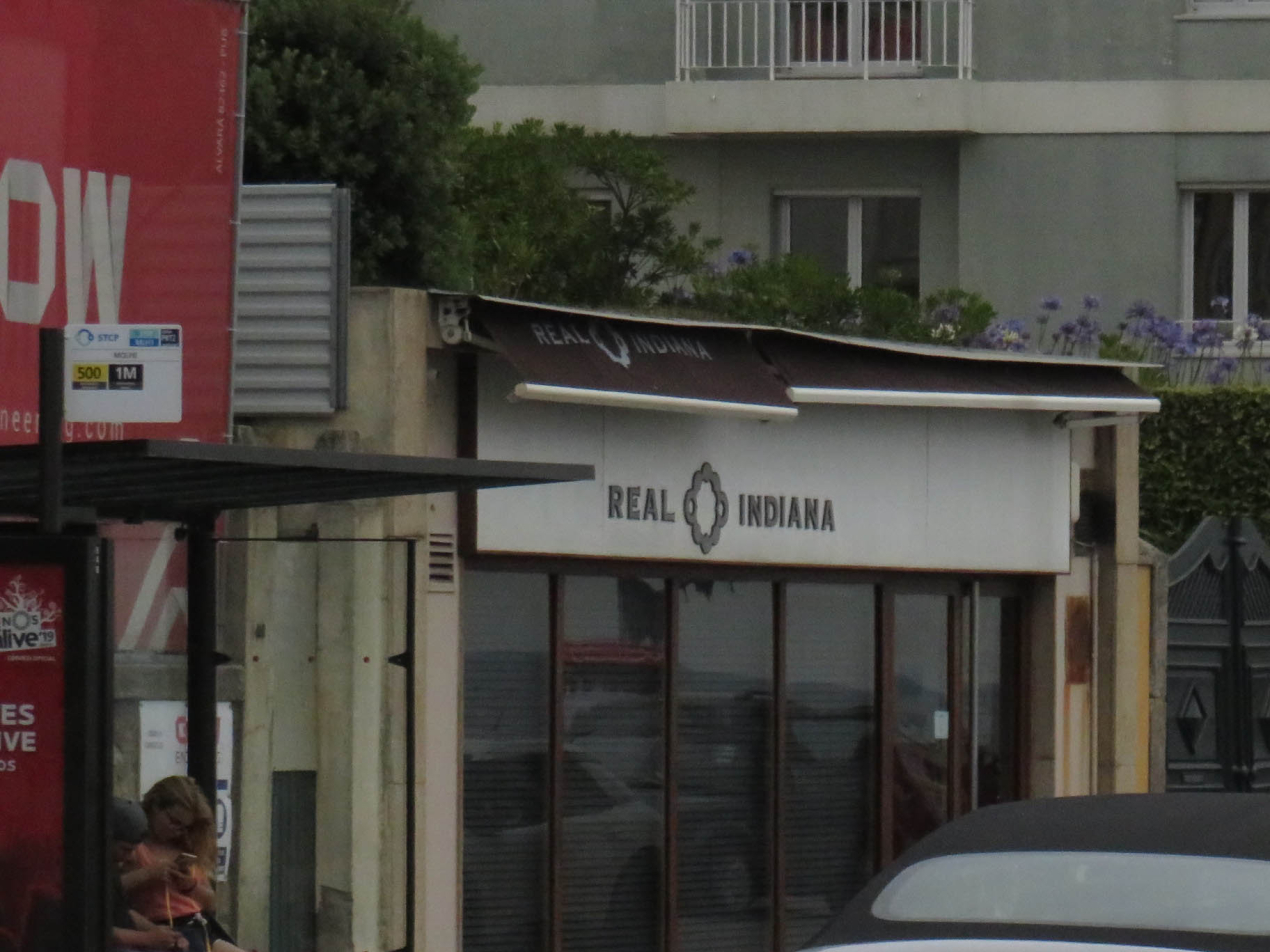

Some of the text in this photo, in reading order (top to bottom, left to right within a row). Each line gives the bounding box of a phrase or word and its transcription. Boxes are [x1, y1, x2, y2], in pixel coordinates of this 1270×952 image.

[97, 333, 120, 342] STCP
[530, 322, 713, 361] REAL INDIANA
[77, 366, 102, 380] 500
[115, 366, 137, 380] 1M
[607, 484, 836, 533] REAL INDIANA
